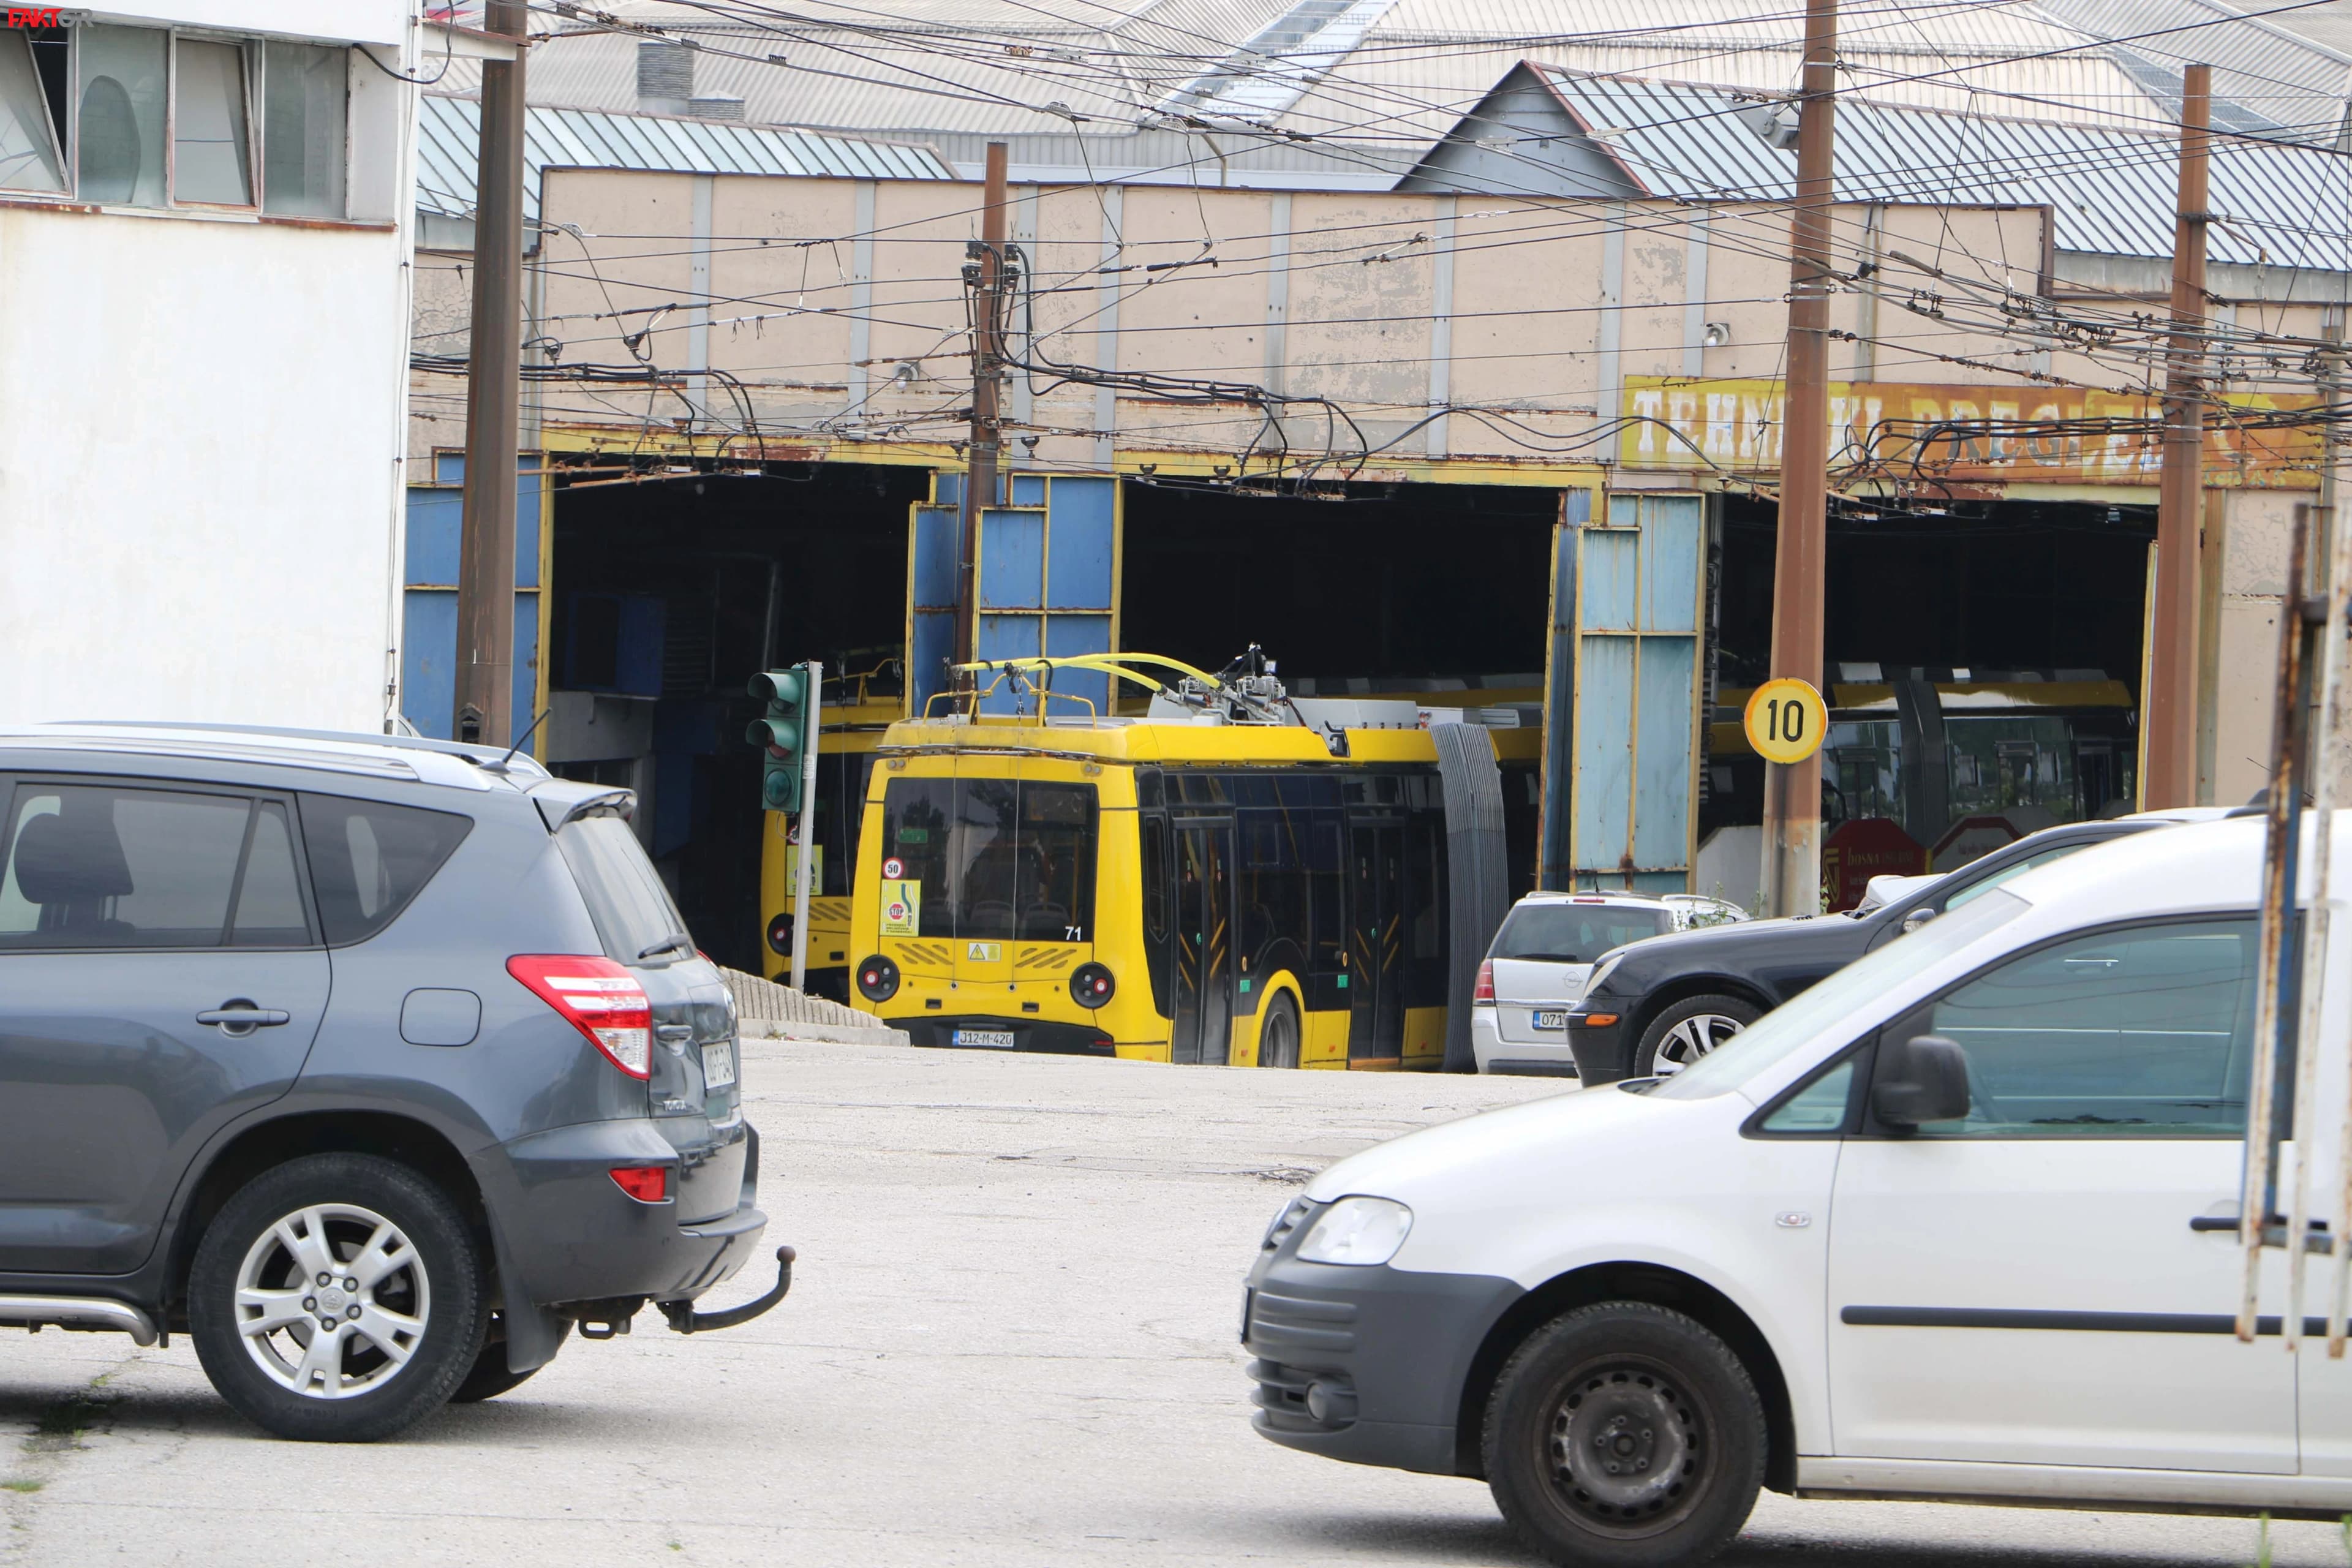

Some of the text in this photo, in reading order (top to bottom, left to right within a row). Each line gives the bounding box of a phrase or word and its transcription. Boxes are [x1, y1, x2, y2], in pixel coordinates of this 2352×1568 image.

[1632, 390, 1883, 461] TEHNKI
[1768, 699, 1804, 742] 10
[887, 864, 899, 874] 50
[1065, 925, 1082, 941] 71
[960, 1031, 1012, 1045] J12-M-420
